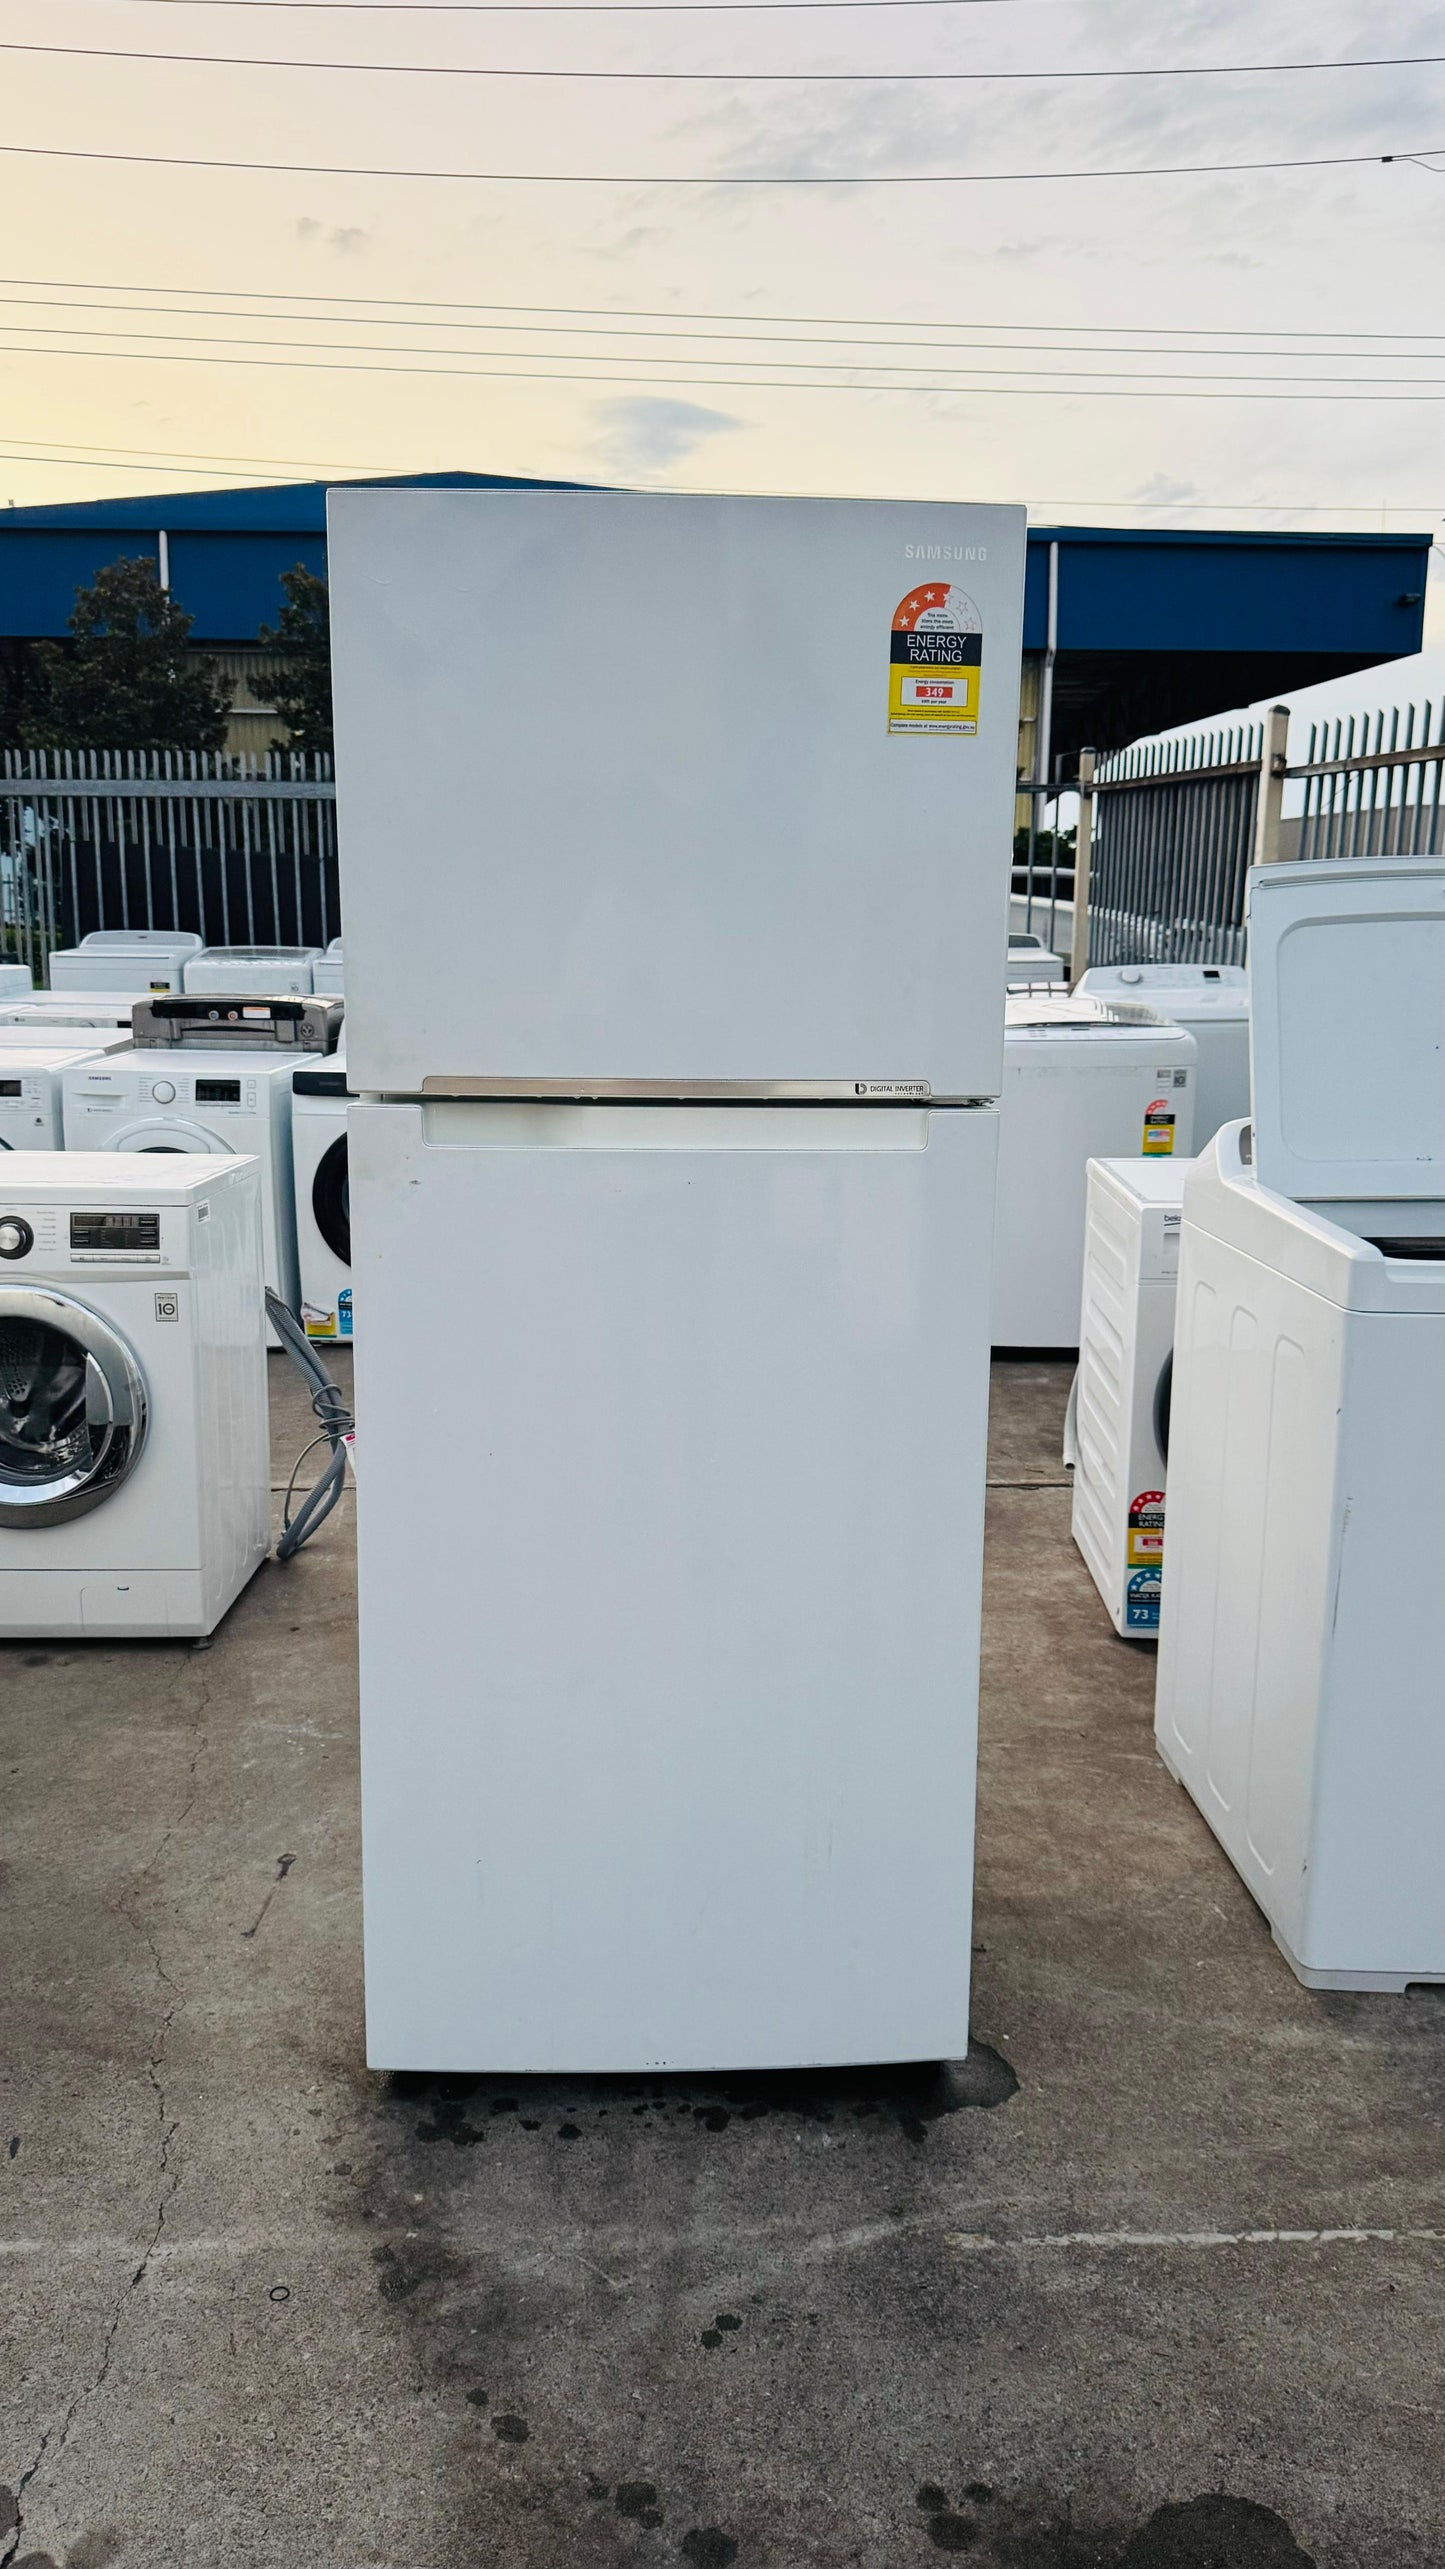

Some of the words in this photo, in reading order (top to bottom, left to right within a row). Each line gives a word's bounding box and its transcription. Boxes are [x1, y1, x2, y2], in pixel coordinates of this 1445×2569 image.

[904, 544, 987, 562] SAMSUNG
[906, 634, 968, 649] ENERGY
[910, 648, 963, 663] RATING
[925, 687, 944, 697] 349
[1133, 1609, 1149, 1620] 73
